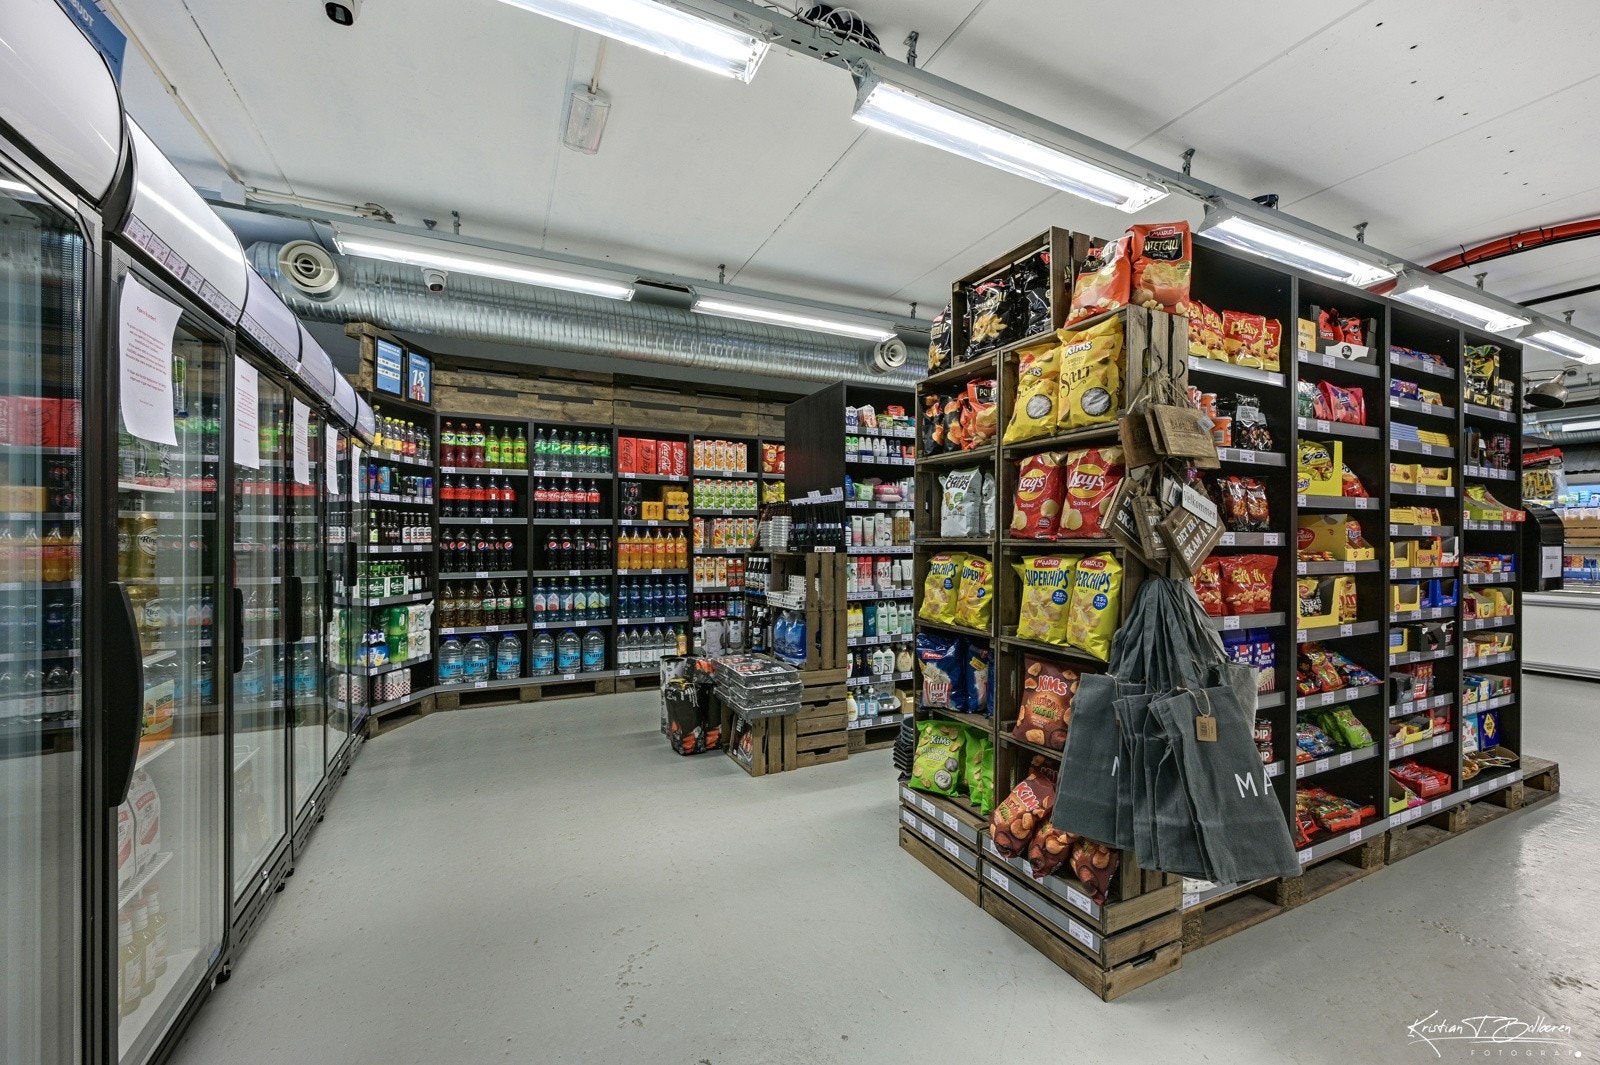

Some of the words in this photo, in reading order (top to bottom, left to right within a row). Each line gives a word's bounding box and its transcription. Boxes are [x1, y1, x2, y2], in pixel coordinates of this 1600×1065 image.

[1144, 239, 1180, 252] OTETGULL
[412, 369, 425, 388] 18
[1185, 488, 1217, 522] Velkommen
[1183, 532, 1205, 561] SKAM
